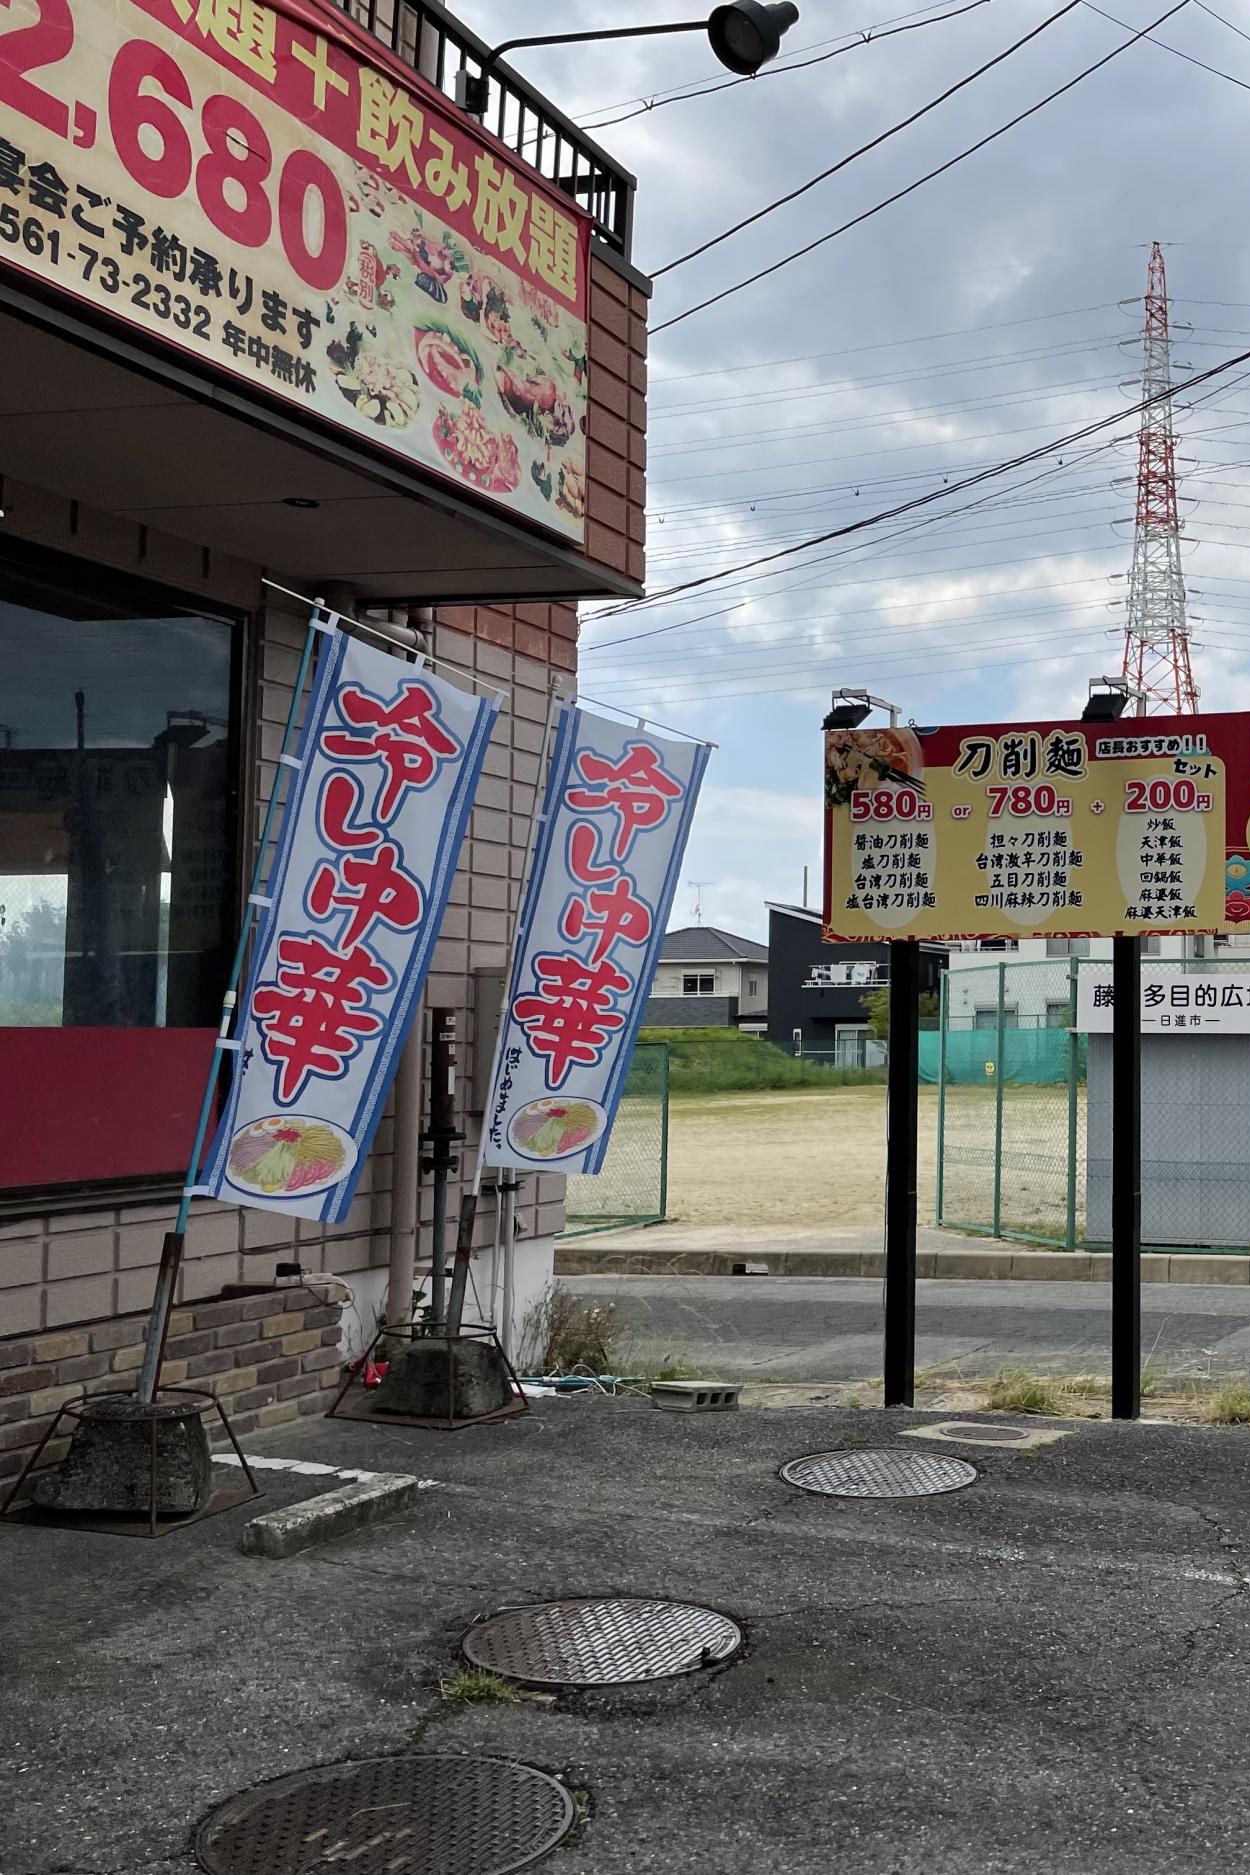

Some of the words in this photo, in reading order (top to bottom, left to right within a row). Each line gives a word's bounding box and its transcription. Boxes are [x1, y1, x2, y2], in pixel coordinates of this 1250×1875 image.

[0, 0, 348, 291] 2,680
[222, 319, 317, 394] 年中無休
[1098, 736, 1206, 755] 店長おすすめ！！
[956, 735, 1085, 778] 刀削麺
[1173, 758, 1218, 778] セット
[852, 790, 931, 819] 580円
[953, 806, 970, 818] or
[988, 786, 1071, 816] 780円
[1126, 780, 1212, 811] 200円
[1146, 817, 1176, 832] 炒飯
[1140, 835, 1183, 850] 天津飯
[861, 852, 922, 870] 塩刀削麺
[975, 850, 1083, 869] 台湾激辛刀削麺
[1140, 852, 1183, 867] 中華飯
[854, 872, 929, 890] 台湾刀削麺
[990, 870, 1067, 888] 五目刀削麺
[1140, 870, 1183, 884] 回鍋飯
[252, 684, 459, 1102] 冷し中華
[846, 891, 937, 909] 塩台湾刀削麺
[974, 890, 1083, 909] 四川麻辣刀削麺
[1139, 888, 1183, 902] 麻婆飯
[511, 743, 685, 1088] 冷し中華
[1124, 905, 1197, 920] 麻婆天津飯
